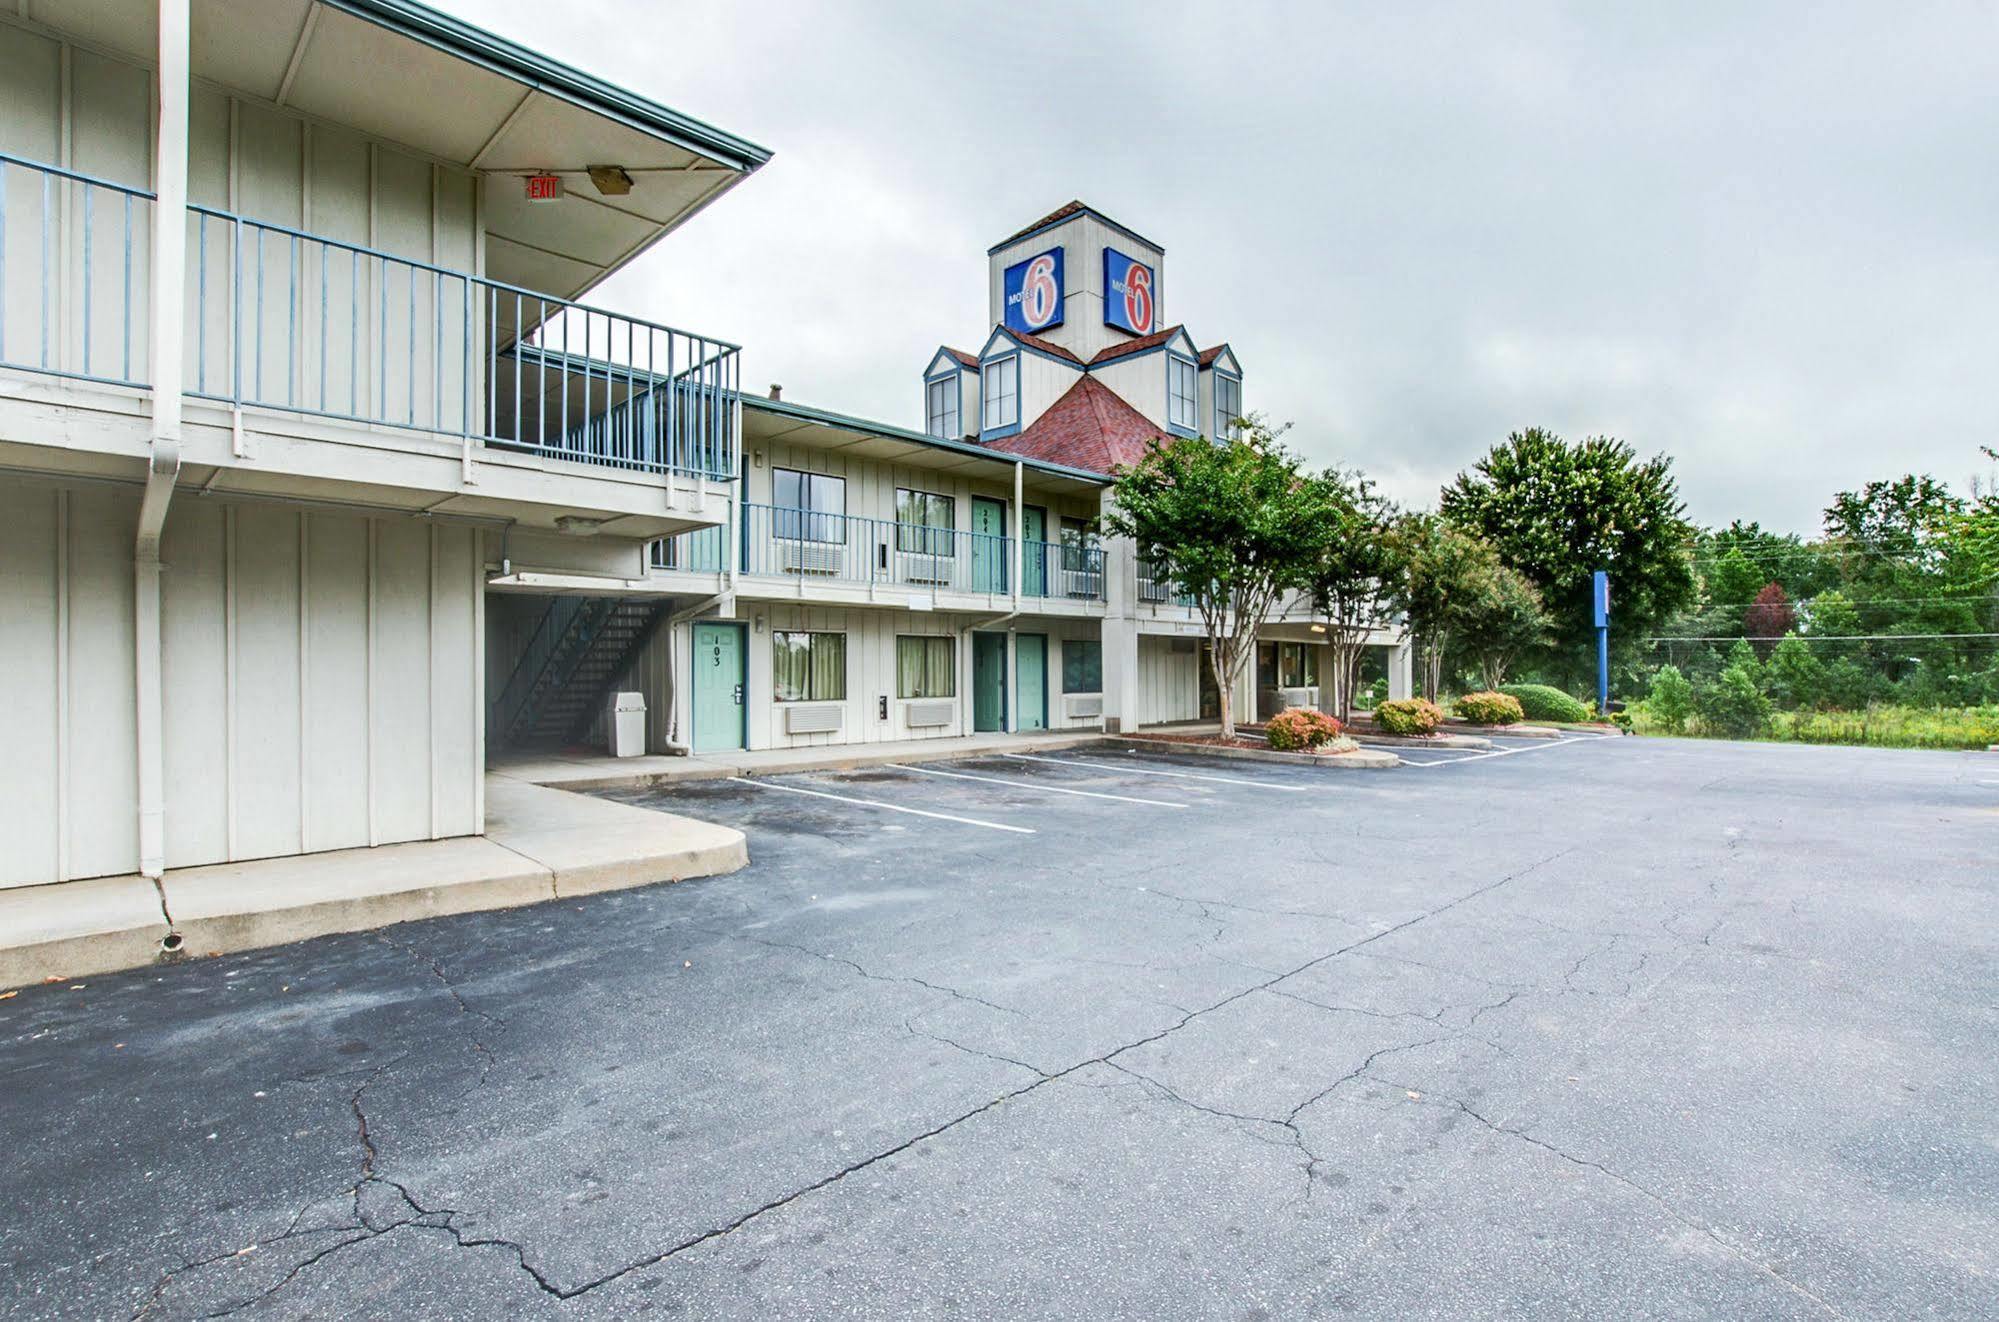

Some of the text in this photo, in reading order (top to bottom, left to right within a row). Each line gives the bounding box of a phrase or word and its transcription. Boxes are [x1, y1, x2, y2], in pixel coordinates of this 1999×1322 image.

[531, 178, 559, 198] EXIT
[1008, 254, 1056, 327] MOTEL 6
[1112, 263, 1153, 331] MOTEL 6
